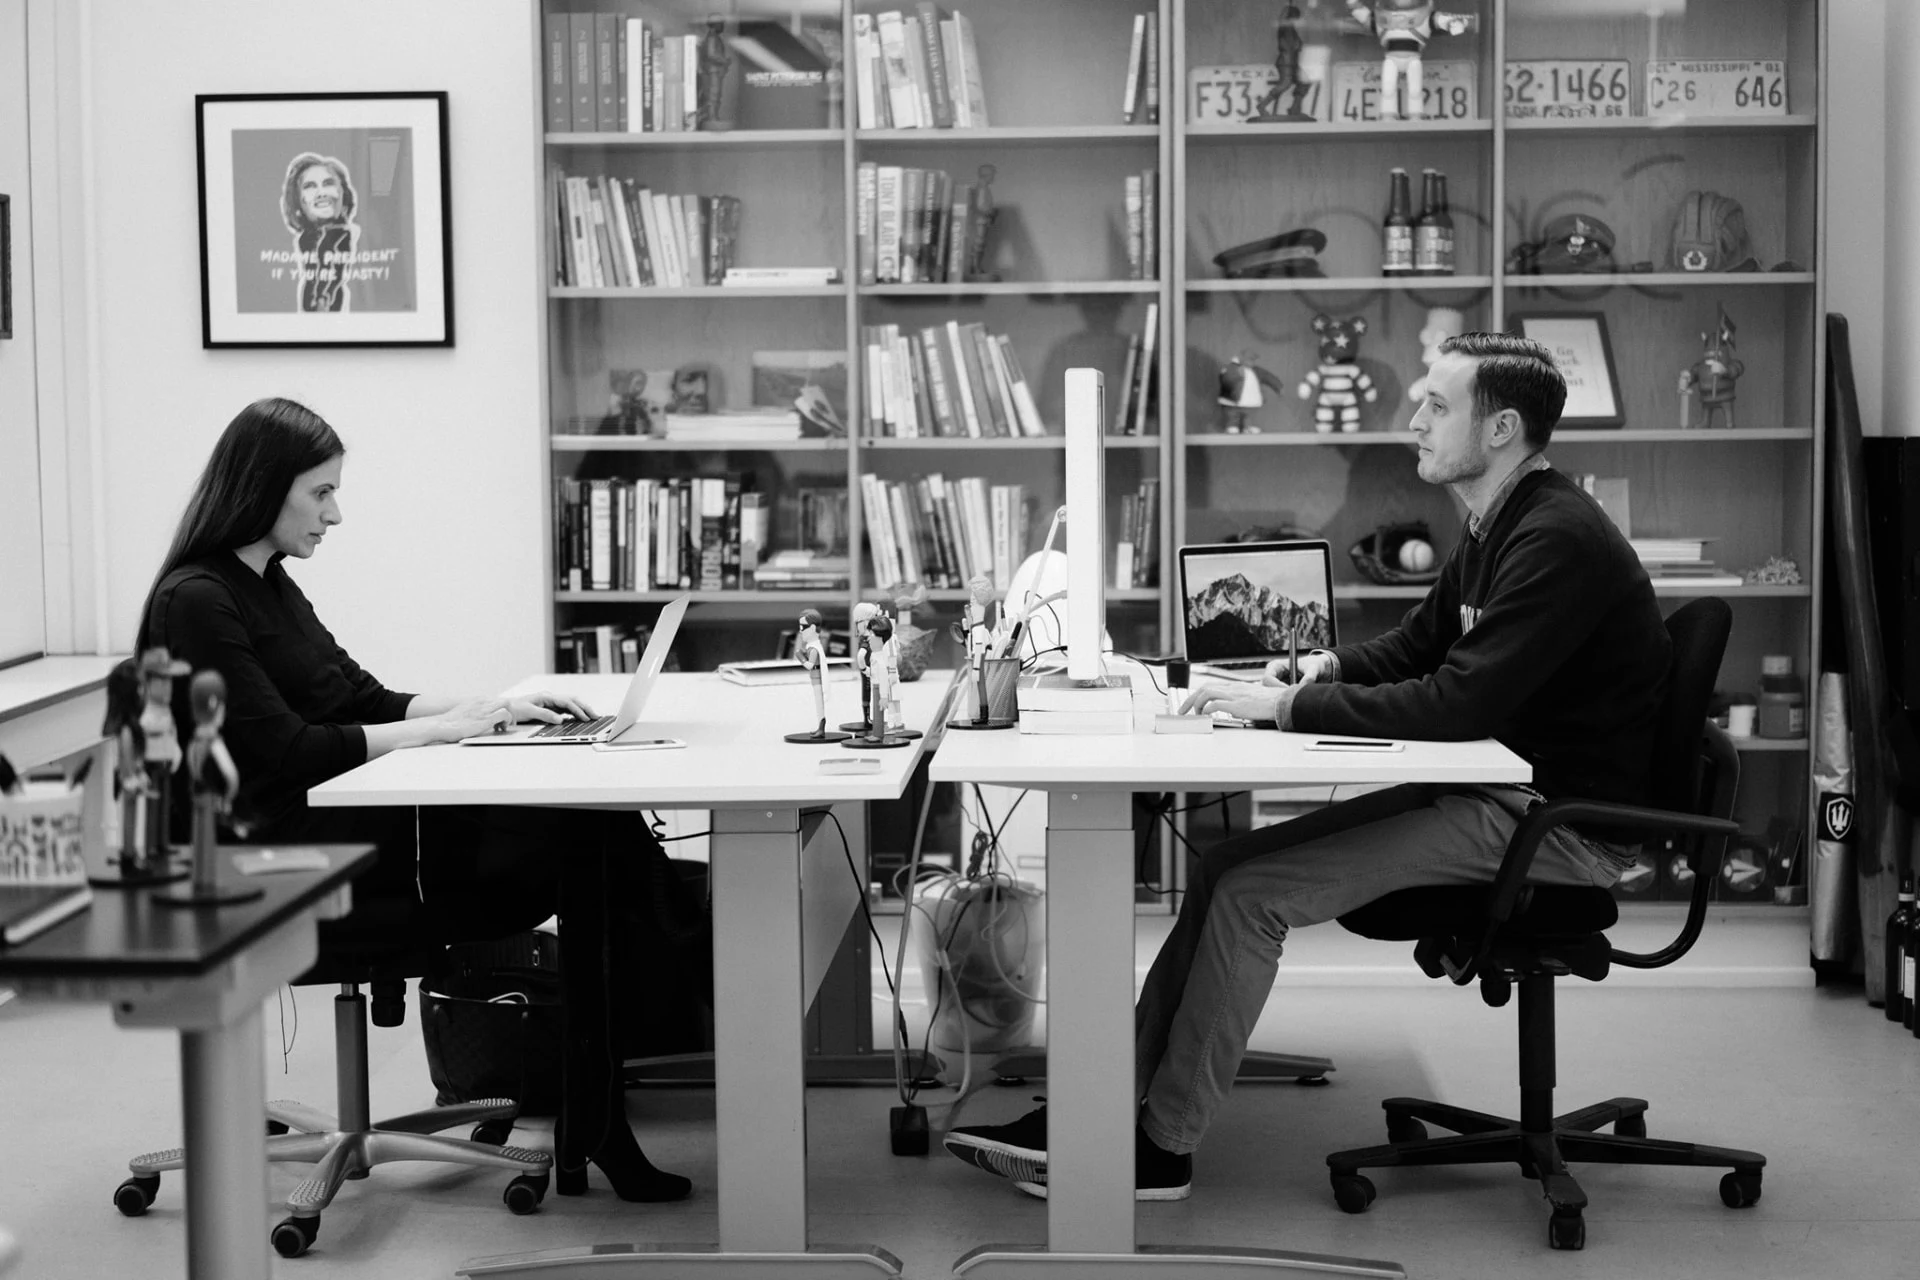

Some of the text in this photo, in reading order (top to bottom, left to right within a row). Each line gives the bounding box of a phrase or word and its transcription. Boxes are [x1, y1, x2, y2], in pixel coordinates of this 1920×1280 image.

[1230, 69, 1278, 79] TEXA
[880, 175, 897, 207] TONY
[880, 209, 897, 247] BLAIR
[260, 248, 400, 265] MADAME PRESIDENT
[272, 267, 285, 280] IF
